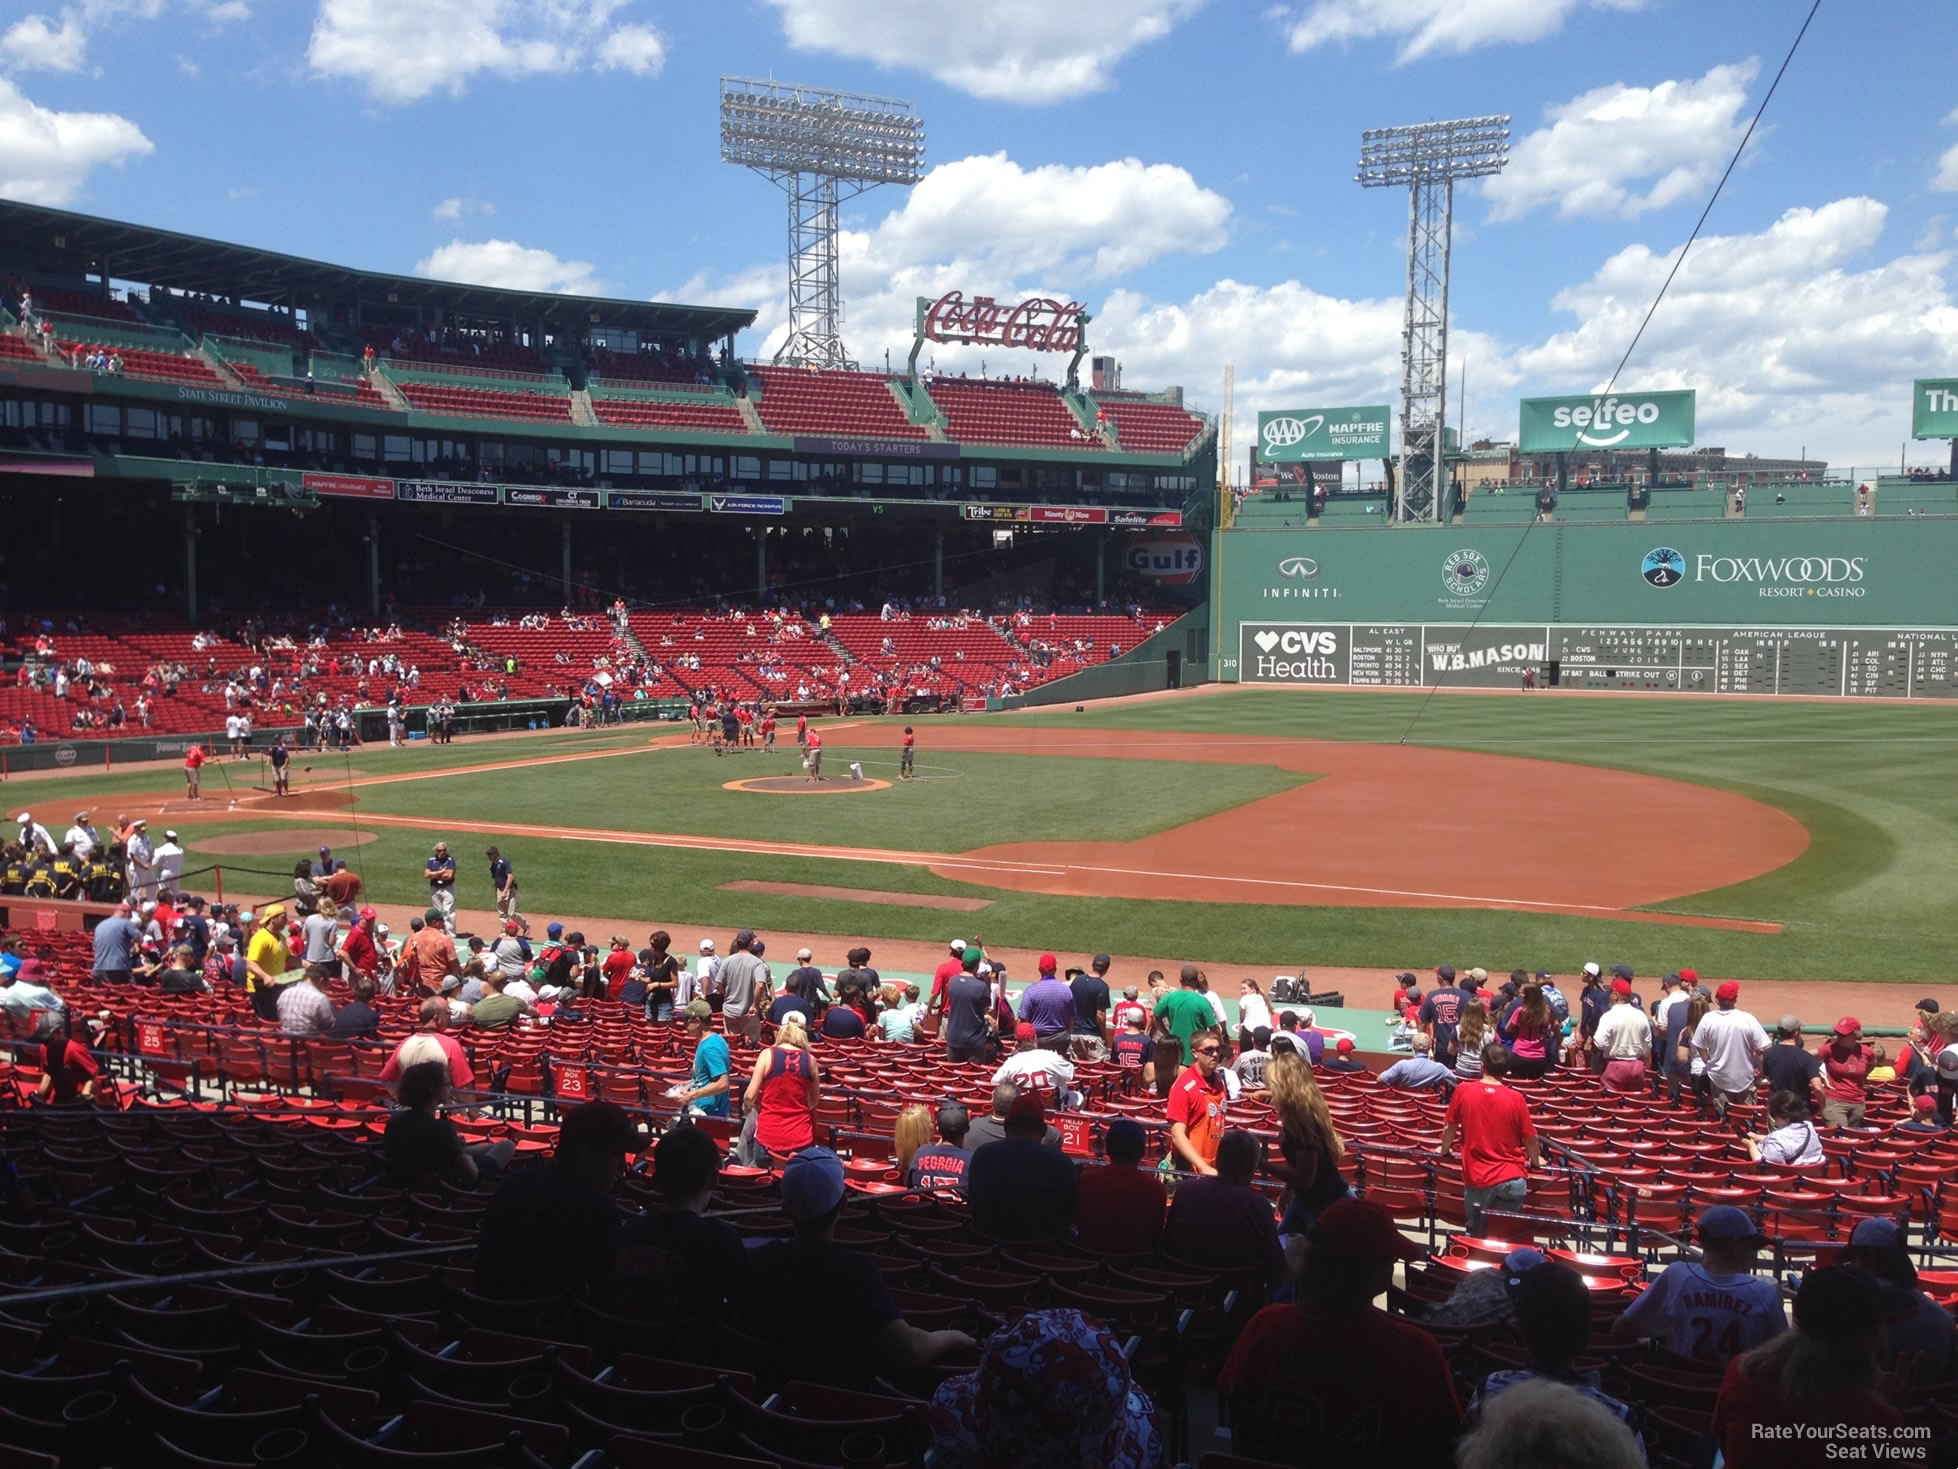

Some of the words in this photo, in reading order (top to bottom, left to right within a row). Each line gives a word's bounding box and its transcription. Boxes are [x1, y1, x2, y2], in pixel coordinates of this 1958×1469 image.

[925, 291, 1087, 353] Coca-Cola
[179, 387, 206, 400] STATE
[208, 390, 241, 404] STREET
[244, 394, 288, 410] PAVILION
[1267, 418, 1302, 446] AAA
[1329, 422, 1384, 434] MAPFRE
[1332, 435, 1381, 446] INSURANCE
[831, 441, 871, 452] TODAY'S
[874, 442, 921, 454] STARTERS
[1280, 471, 1294, 480] We
[415, 484, 433, 493] Beth
[435, 486, 455, 494] Israel
[457, 487, 494, 496] Deaconess
[416, 492, 445, 501] Medical
[447, 494, 472, 502] Center
[622, 498, 657, 506] Barracuda
[872, 505, 884, 514] VS
[967, 506, 991, 518] Tribe
[1044, 510, 1064, 519] Ninety
[1075, 511, 1089, 519] Nine
[1114, 515, 1147, 524] Safelite
[1128, 547, 1199, 569] Gulf
[1444, 553, 1460, 572] RED
[1463, 551, 1481, 563] SOX
[1694, 554, 1864, 582] FOXWOODS
[1446, 567, 1488, 594] SCHOLARS
[1263, 588, 1337, 598] INFINITI
[1759, 587, 1804, 597] RESORT
[1816, 587, 1865, 597] CASINO
[1280, 630, 1336, 655] CVS
[1426, 645, 1445, 653] WHO
[1446, 645, 1460, 653] BUT
[1223, 659, 1237, 668] 310
[1256, 656, 1337, 679] Health
[1496, 666, 1521, 674] SINCE
[1643, 671, 1660, 679] OUT
[1435, 1004, 1459, 1024] 15
[143, 1036, 160, 1047] 25
[1118, 1052, 1144, 1067] 15
[562, 1079, 581, 1091] 23
[1013, 1071, 1050, 1088] 20
[1060, 1117, 1084, 1126] FIELD
[1063, 1124, 1080, 1132] BOX
[1063, 1133, 1080, 1145] 21
[918, 1155, 965, 1175] PEDROIA
[1683, 1292, 1753, 1319] RAMIREZ
[1690, 1316, 1742, 1359] 24
